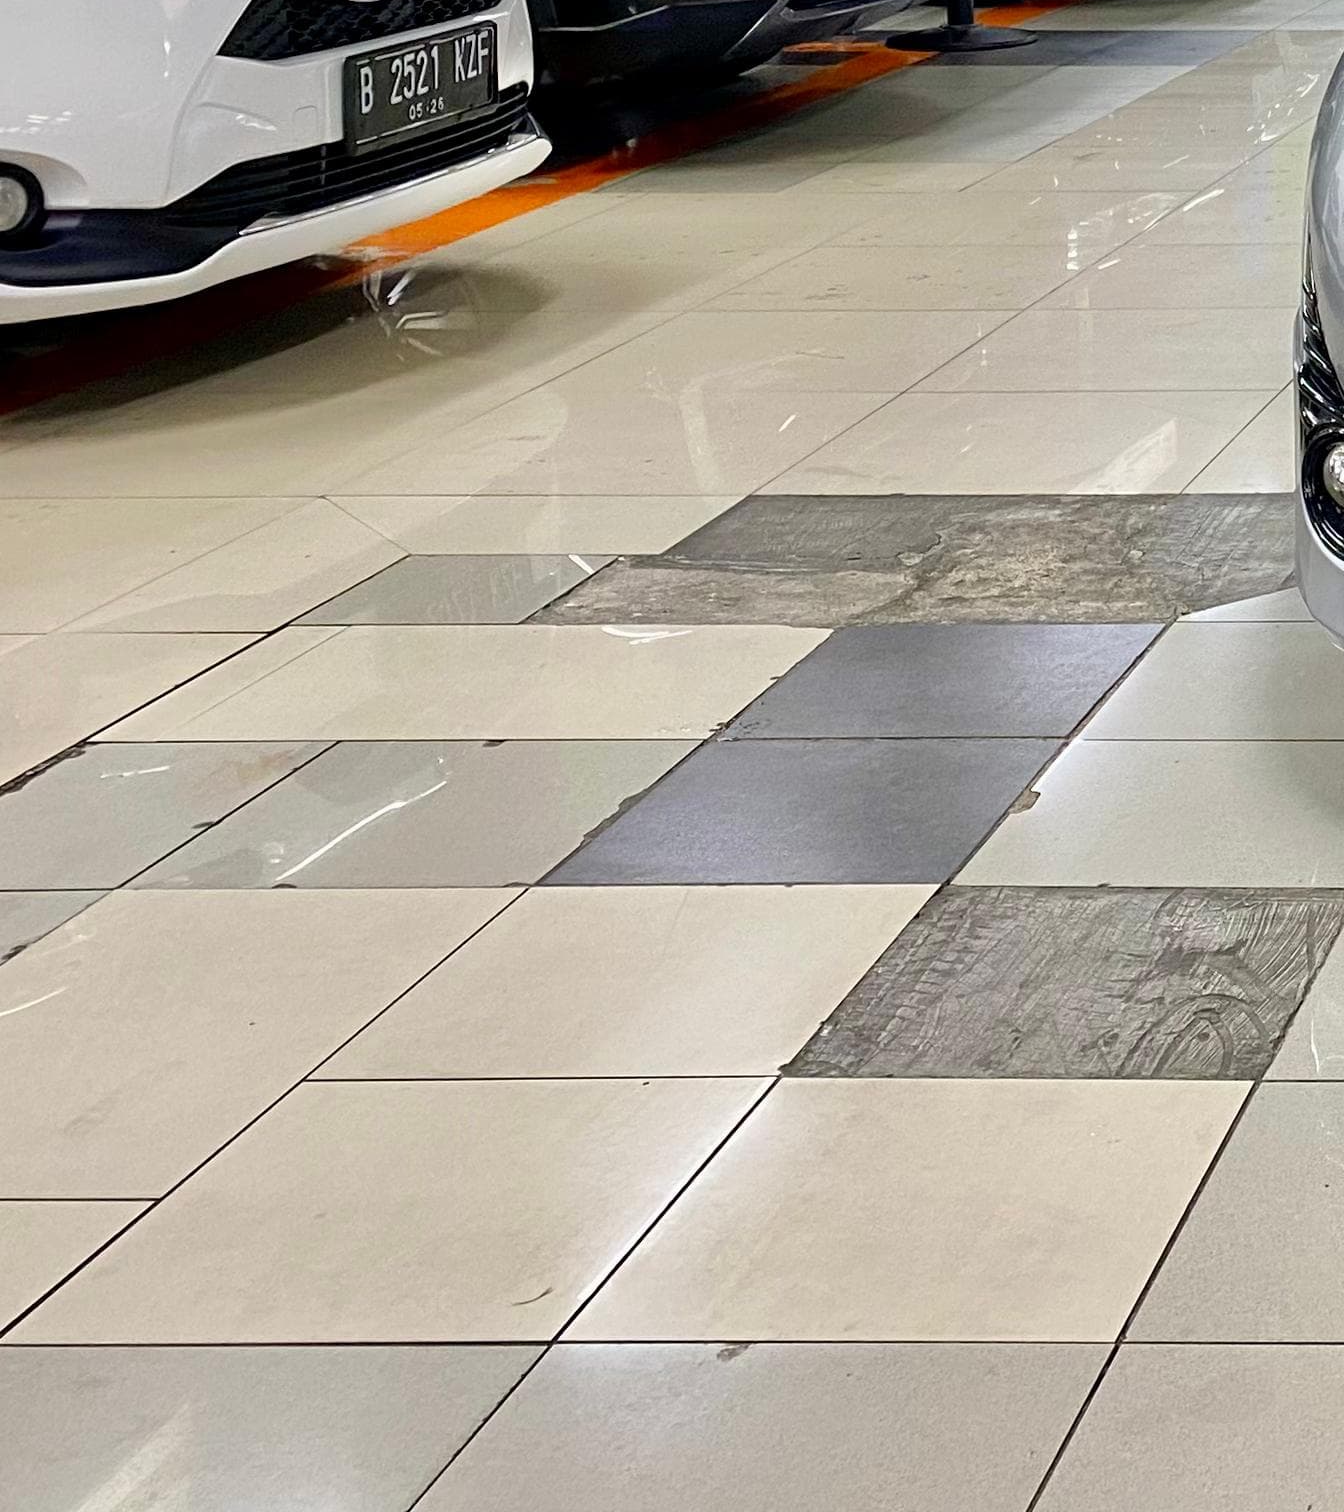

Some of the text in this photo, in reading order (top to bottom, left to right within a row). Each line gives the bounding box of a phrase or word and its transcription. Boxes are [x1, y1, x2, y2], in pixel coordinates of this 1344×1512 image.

[360, 30, 489, 115] B 2521 KZF
